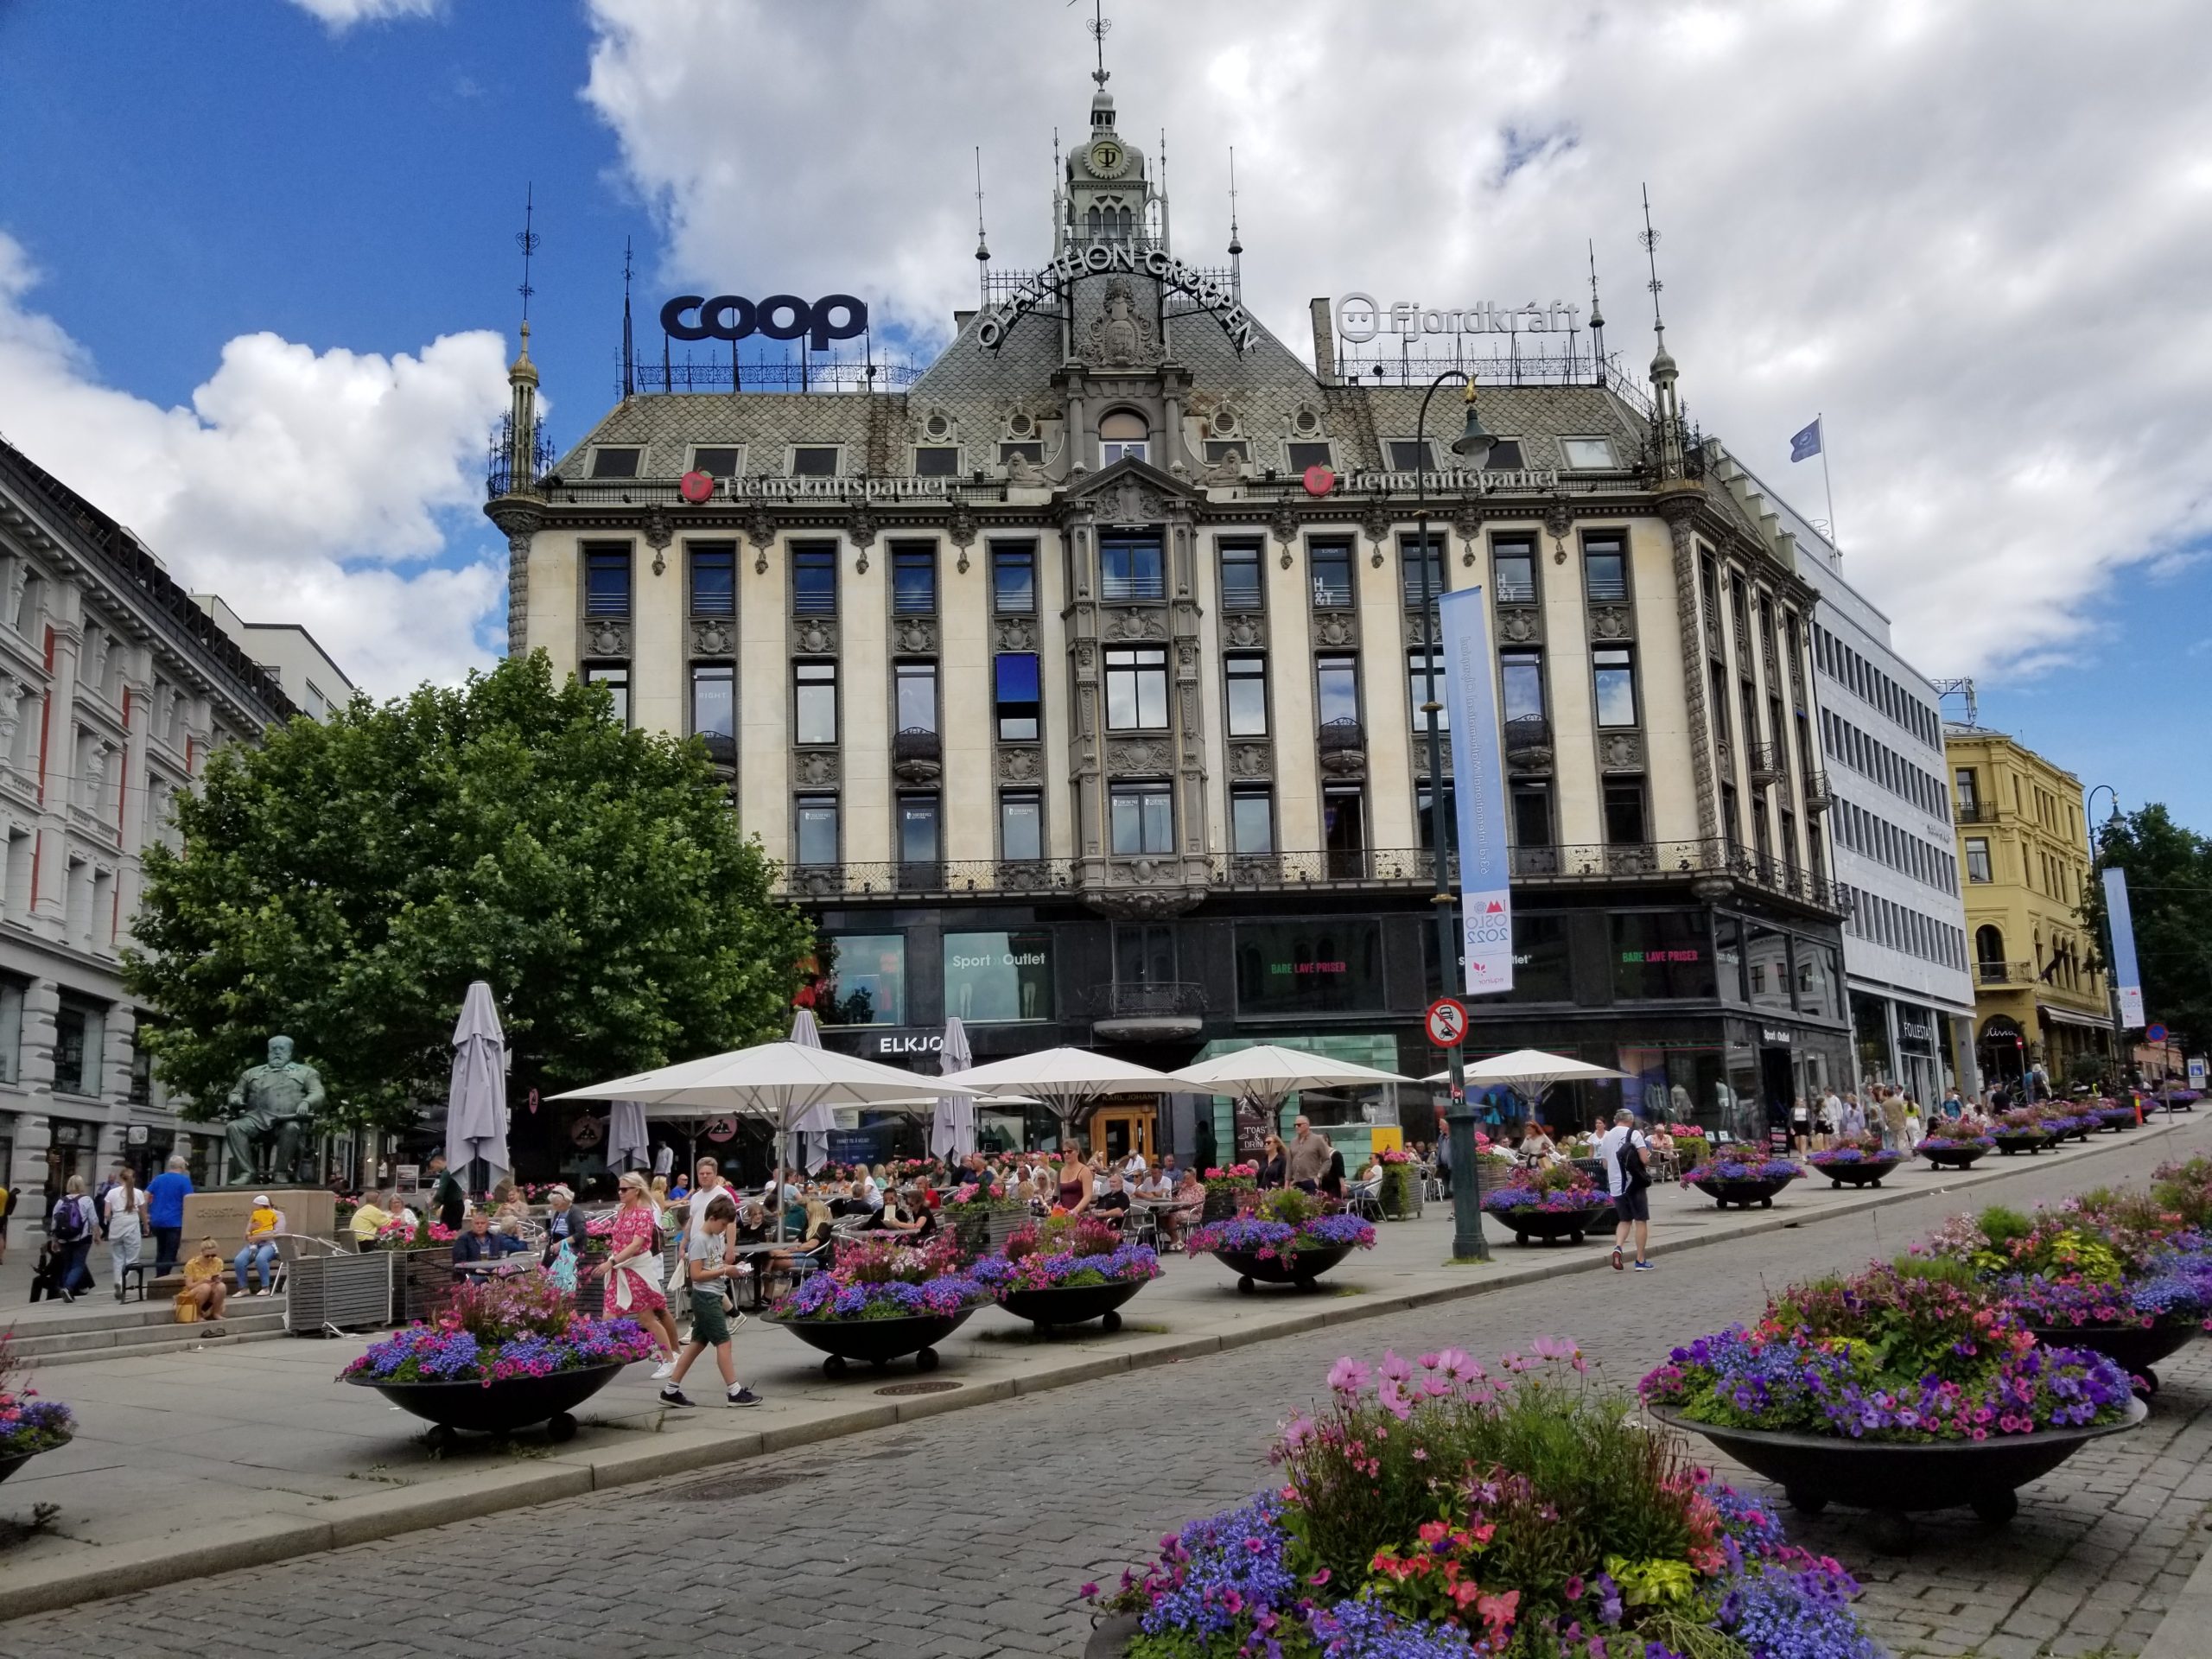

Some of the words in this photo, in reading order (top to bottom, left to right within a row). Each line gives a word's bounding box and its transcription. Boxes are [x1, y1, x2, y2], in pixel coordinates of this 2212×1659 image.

[977, 269, 1042, 347] OLAV
[1047, 243, 1135, 283] THON
[1145, 250, 1261, 351] GRUPPEN
[660, 294, 868, 351] coop
[952, 954, 990, 969] Sport
[1002, 953, 1046, 966] Outlet
[1623, 952, 1644, 963] BARE
[1645, 951, 1666, 962] LAVE
[1668, 950, 1698, 961] PRISER
[1271, 963, 1293, 974] BARE
[1294, 963, 1314, 973] LAVE
[1317, 962, 1345, 972] PRISER
[1764, 1029, 1776, 1041] Sport
[1777, 1031, 1789, 1042] Outlet
[1904, 1022, 1933, 1041] FOLLESTAD
